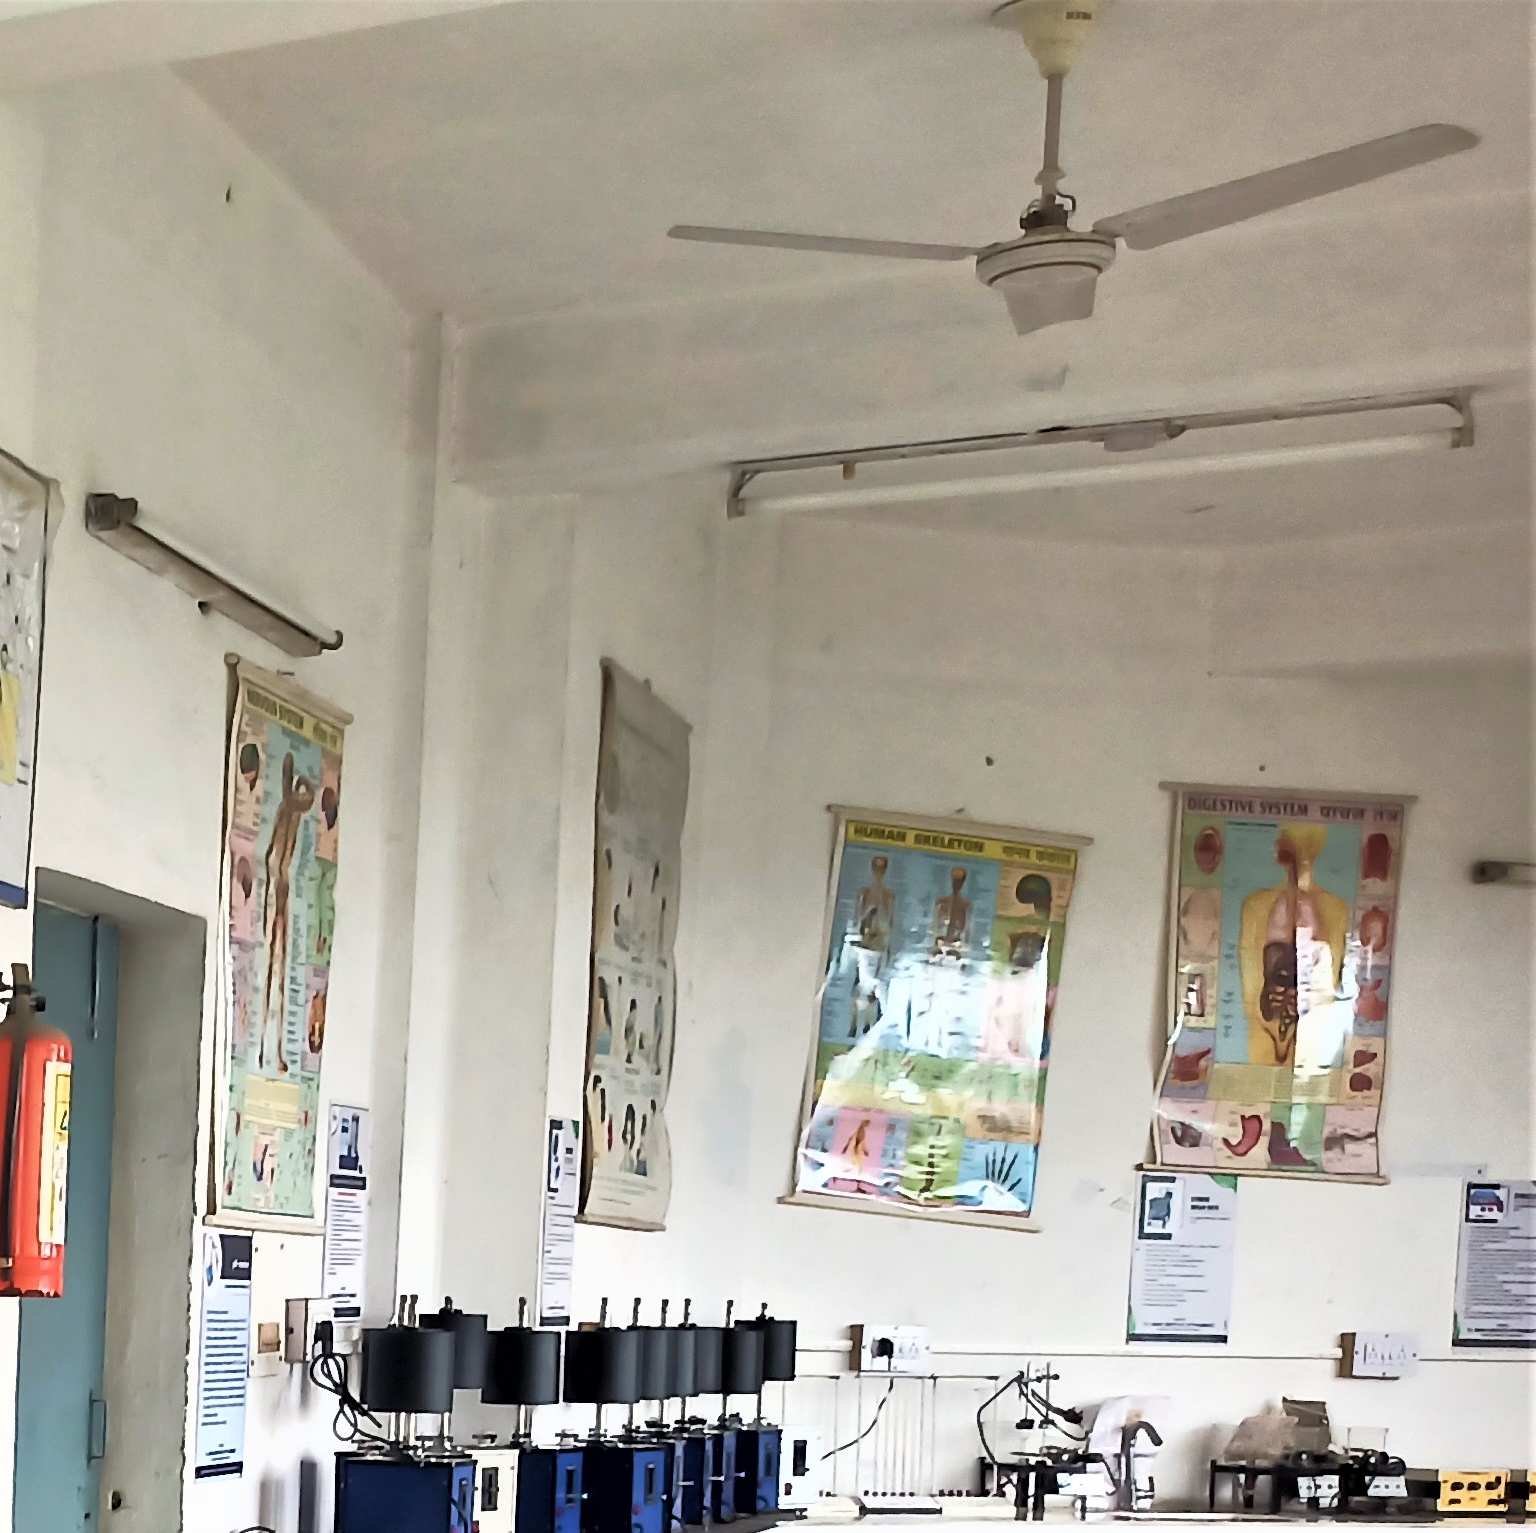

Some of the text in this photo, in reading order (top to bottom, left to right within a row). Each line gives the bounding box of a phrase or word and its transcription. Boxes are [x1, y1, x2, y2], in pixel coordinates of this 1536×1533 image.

[1188, 797, 1308, 816] DIGESTIVE SYSTEM
[854, 825, 907, 842] HUMAN
